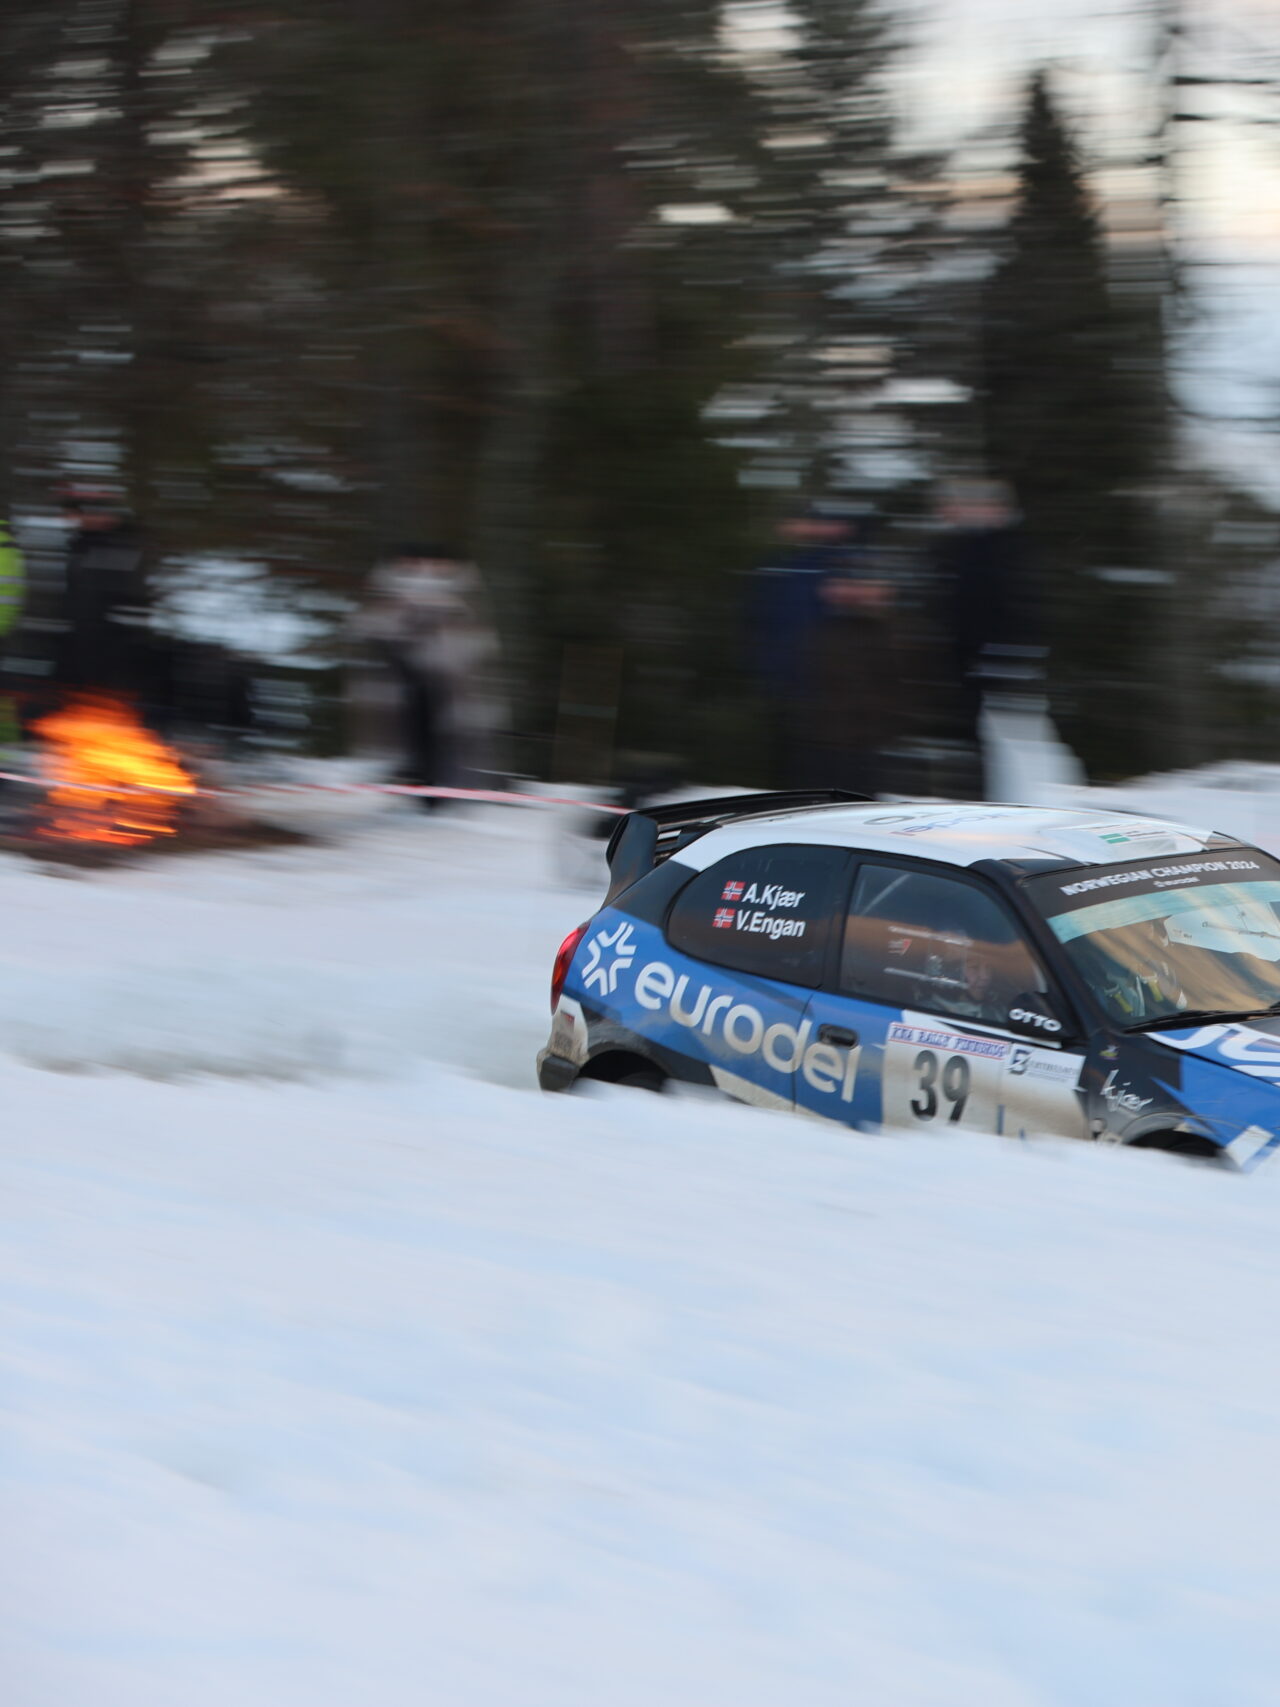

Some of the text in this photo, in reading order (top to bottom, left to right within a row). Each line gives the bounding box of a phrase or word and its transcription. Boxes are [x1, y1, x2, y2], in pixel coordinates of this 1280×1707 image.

[1059, 860, 1260, 896] NORWEGIAN CHAMPION 2024
[741, 882, 806, 911] A.Kjær
[736, 909, 806, 940] V.Engan
[634, 961, 863, 1104] eurodel
[1008, 1007, 1062, 1032] OTTO
[910, 1049, 970, 1122] 39
